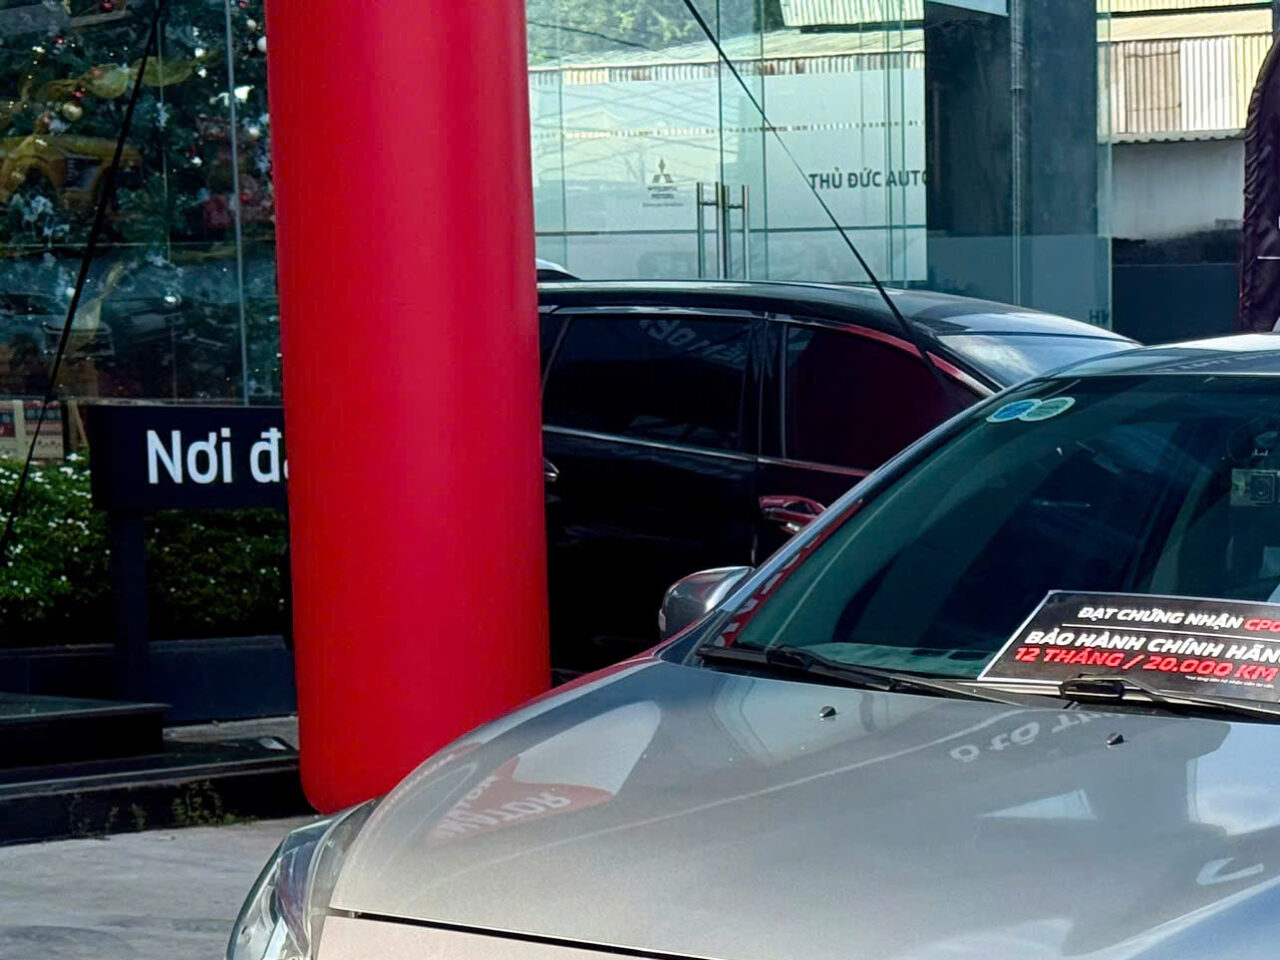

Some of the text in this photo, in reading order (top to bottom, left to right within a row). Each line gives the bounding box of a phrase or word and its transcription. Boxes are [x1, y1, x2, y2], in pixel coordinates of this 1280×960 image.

[809, 166, 842, 190] THỦ
[847, 167, 882, 188] ĐỨC
[147, 427, 289, 484] Nơi đ
[1077, 606, 1118, 622] ĐẠT
[1117, 607, 1184, 625] CHỨNG
[1185, 612, 1244, 631] NHẬN
[1024, 628, 1074, 647] BẢO
[1075, 631, 1141, 650] HÀNH
[1147, 635, 1221, 657] CHÍNH
[1014, 648, 1037, 662] 12
[1043, 646, 1123, 668] THÁNG
[1122, 654, 1144, 670] /
[1142, 656, 1233, 678] 20.000
